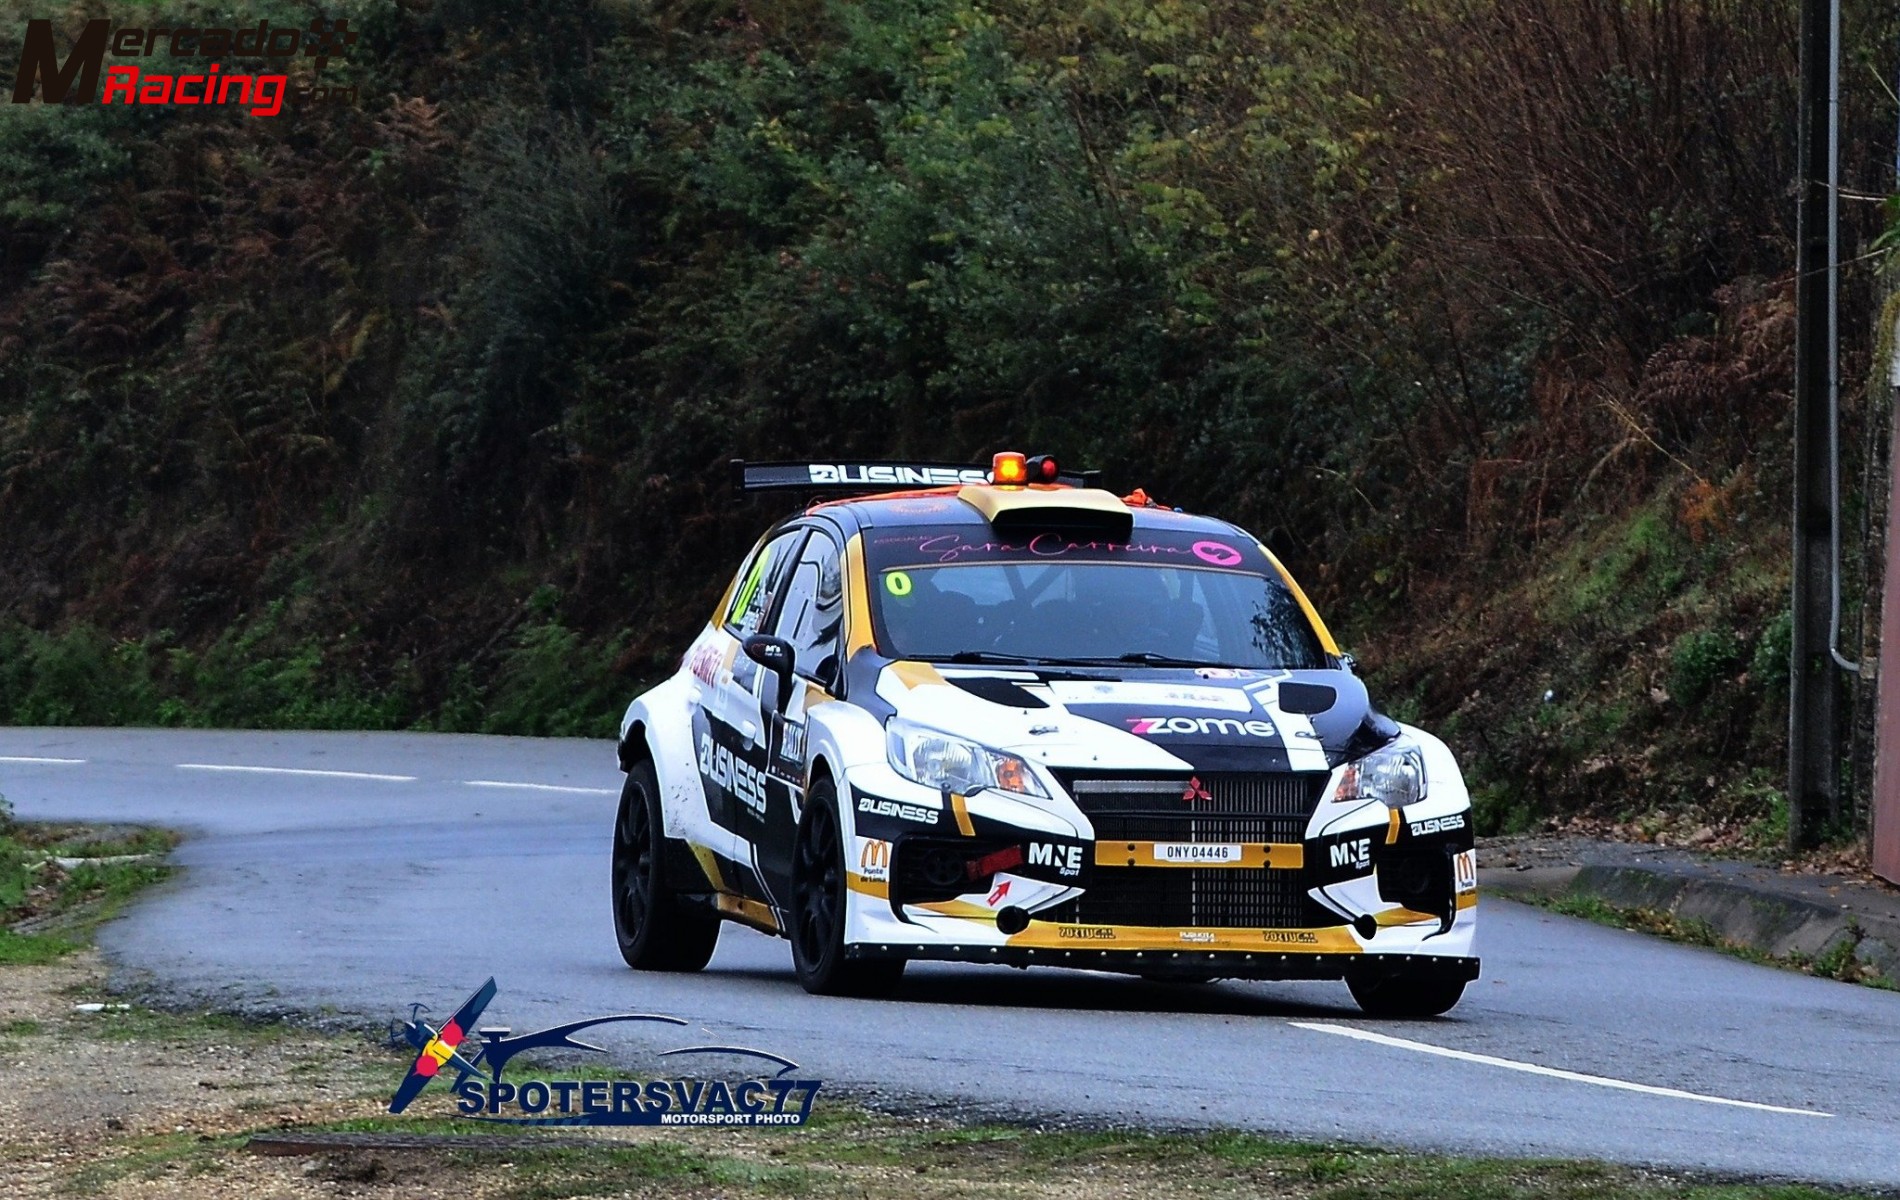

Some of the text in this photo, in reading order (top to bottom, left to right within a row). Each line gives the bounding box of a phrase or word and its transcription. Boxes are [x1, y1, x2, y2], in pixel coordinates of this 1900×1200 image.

[886, 572, 911, 595] 0
[700, 733, 767, 814] BUSINESS
[858, 798, 939, 824] BUSINESS
[1410, 814, 1465, 837] BUSINESS
[1028, 842, 1083, 869] MNE
[1330, 838, 1371, 868] MNE
